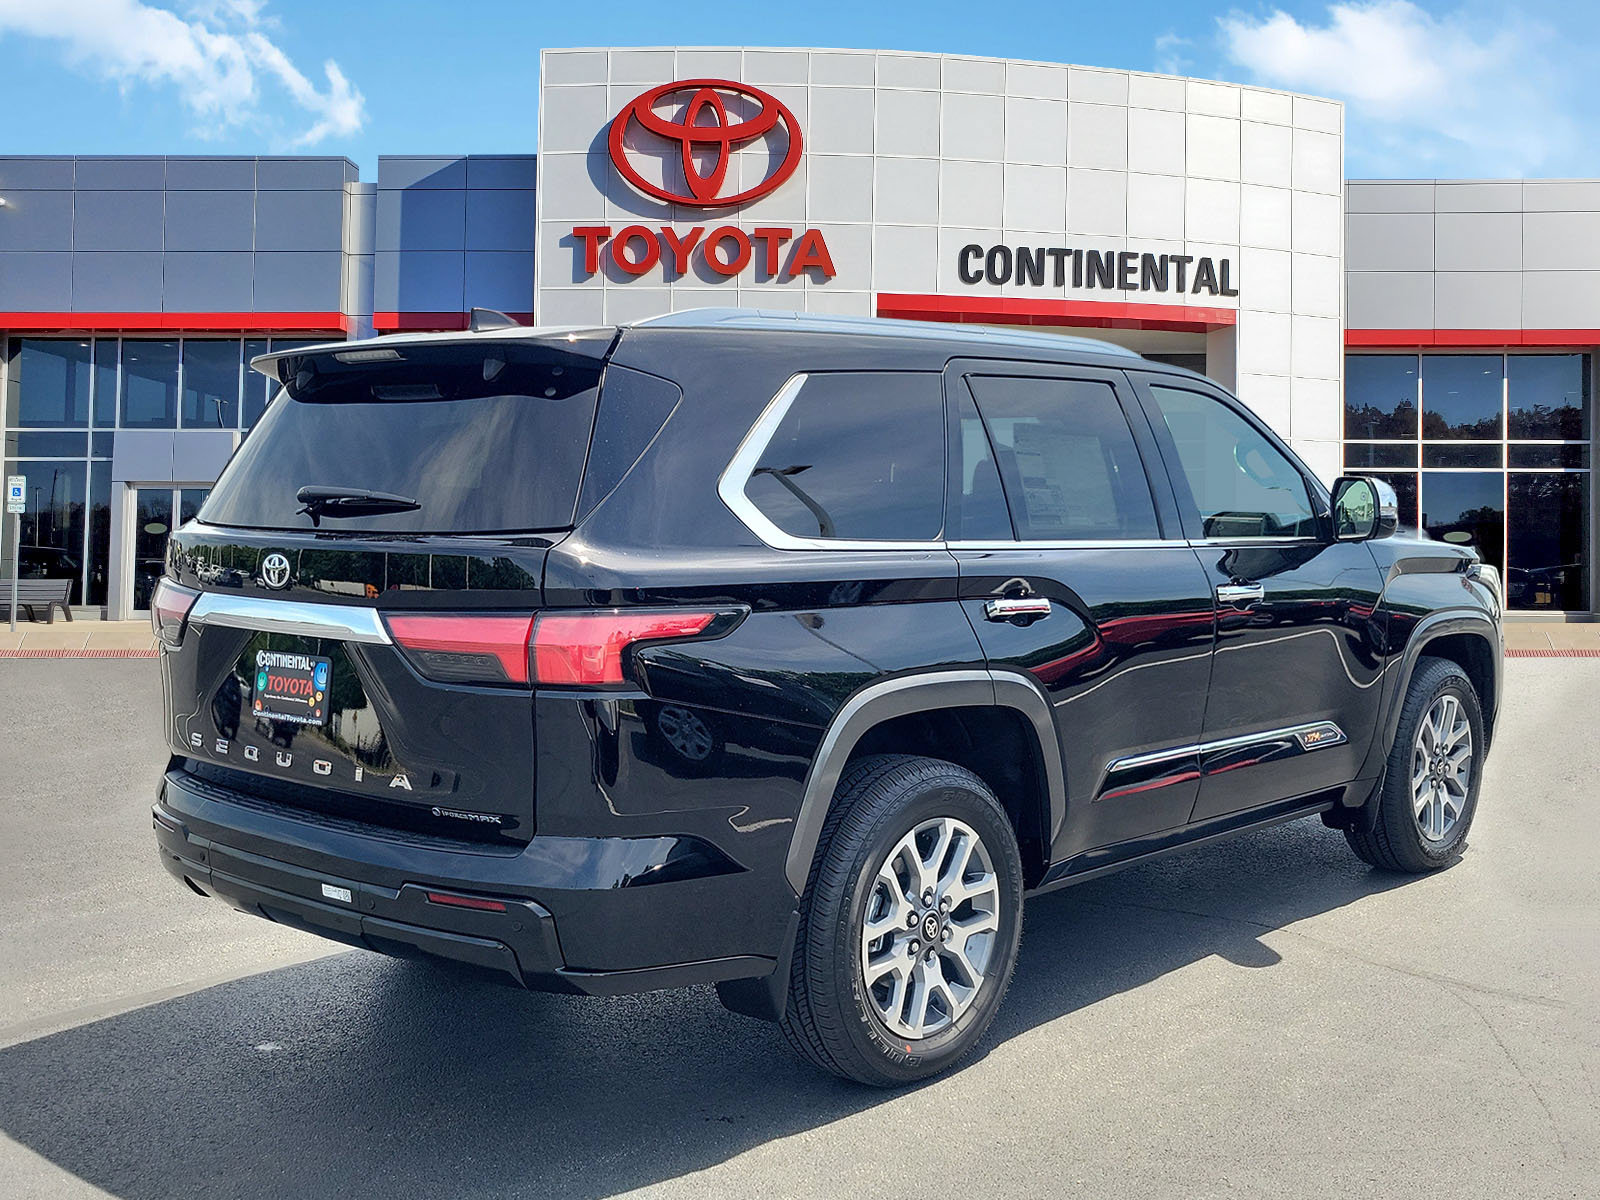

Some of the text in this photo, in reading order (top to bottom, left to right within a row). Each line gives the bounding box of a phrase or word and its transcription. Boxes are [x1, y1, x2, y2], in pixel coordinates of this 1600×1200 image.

[572, 225, 837, 277] TOYOTA
[959, 244, 1239, 296] CONTINENTAL
[256, 650, 312, 671] CONTINENTAL
[268, 675, 314, 696] TOYOTA
[252, 709, 322, 726] ContinentalToyota.com
[191, 732, 413, 791] SEQUOIA
